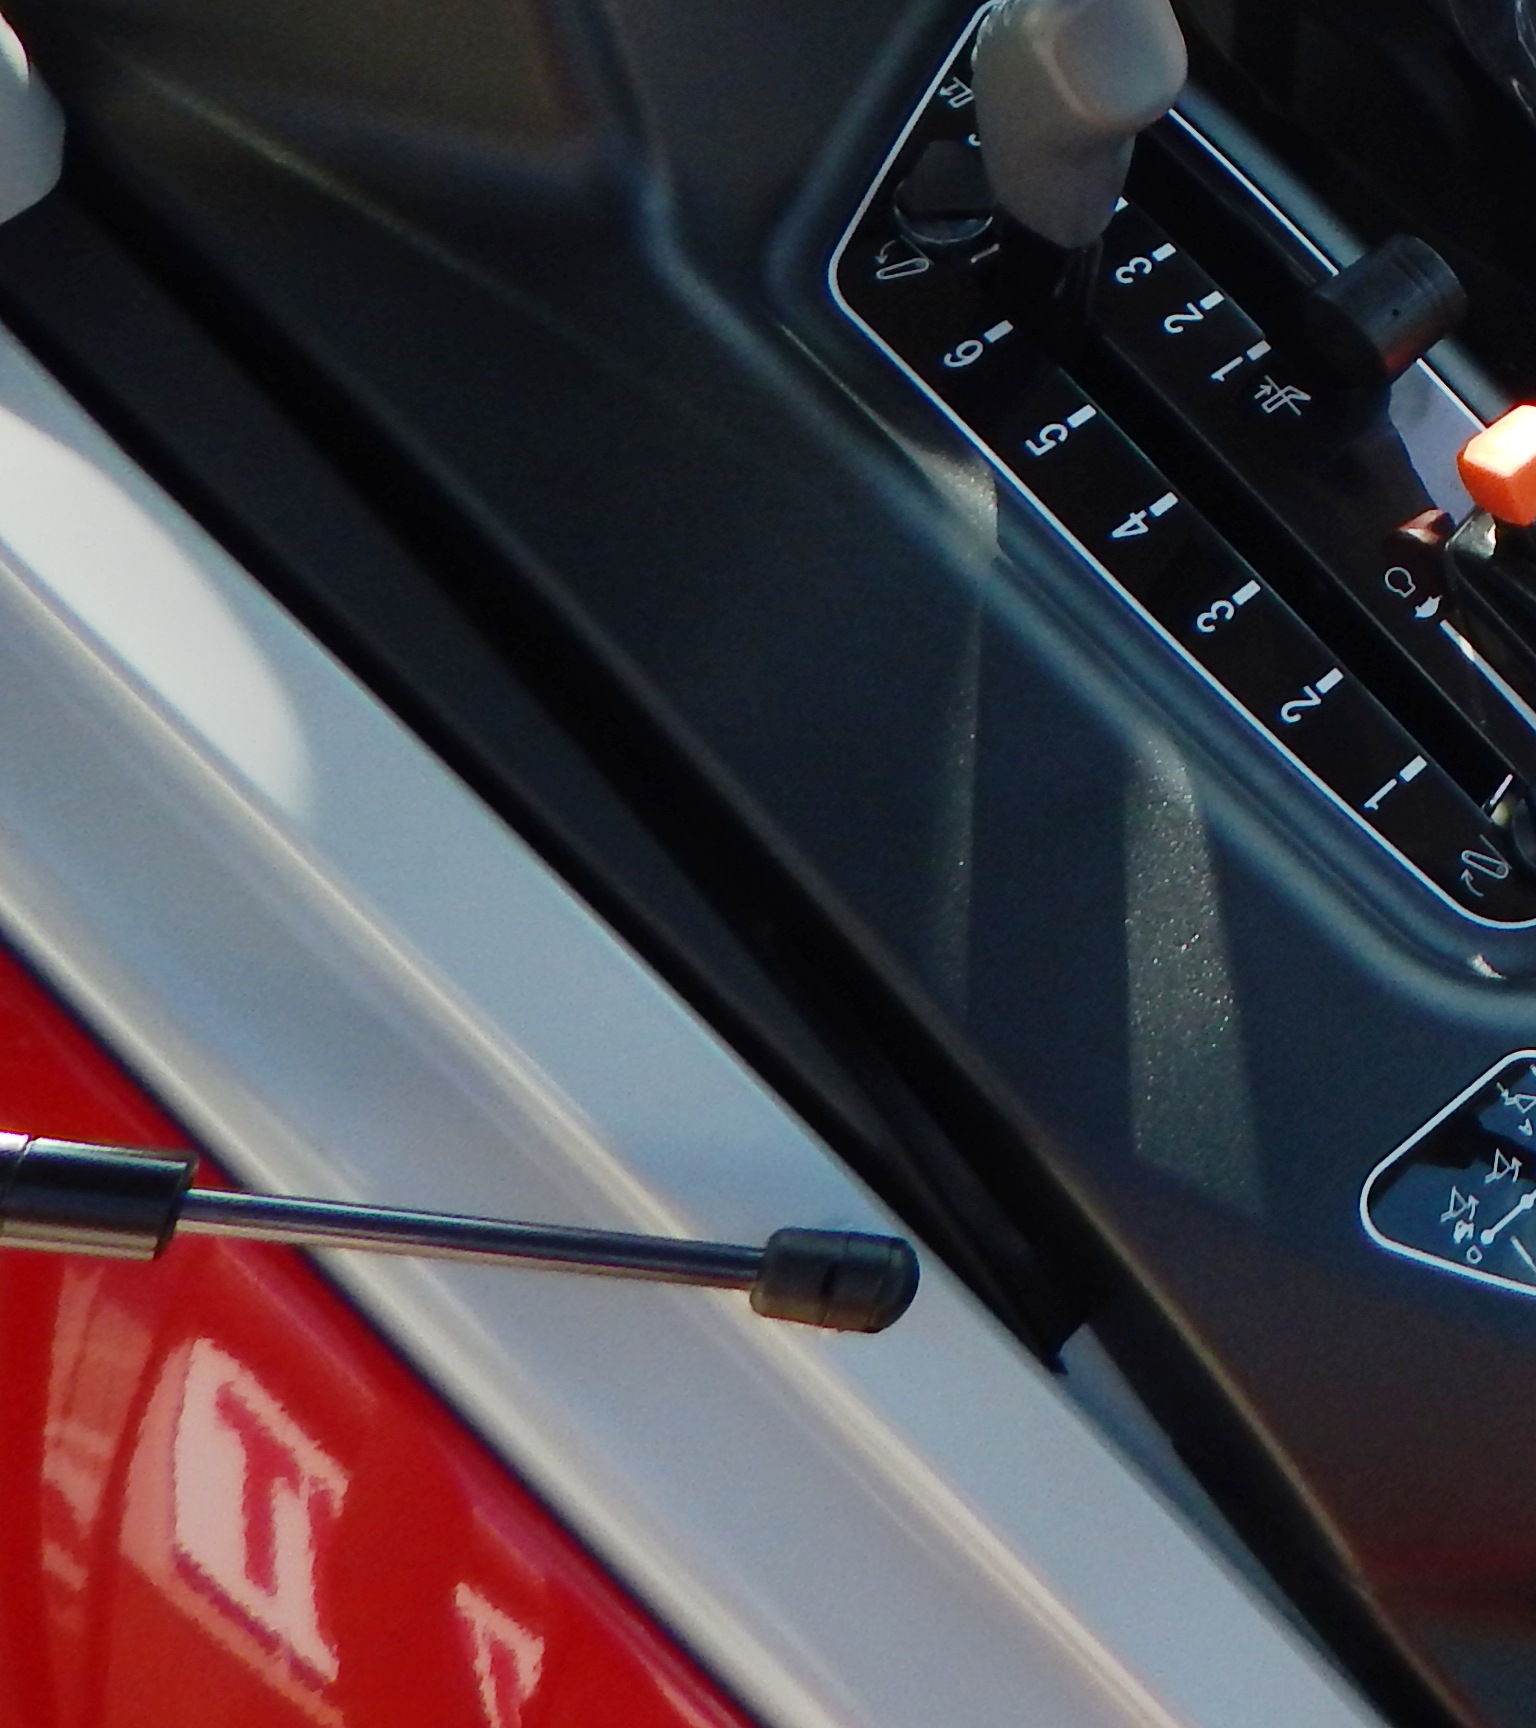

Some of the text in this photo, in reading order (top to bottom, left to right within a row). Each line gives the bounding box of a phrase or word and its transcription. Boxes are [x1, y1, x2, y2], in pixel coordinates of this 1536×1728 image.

[1115, 256, 1152, 284] 3
[1164, 302, 1204, 334] 2
[944, 340, 983, 368] 6
[1211, 356, 1243, 382] 1
[1025, 423, 1068, 456] 5
[1111, 509, 1149, 538] 4
[1196, 600, 1235, 633] 3
[1280, 685, 1322, 723] 2
[1364, 778, 1398, 810] 1
